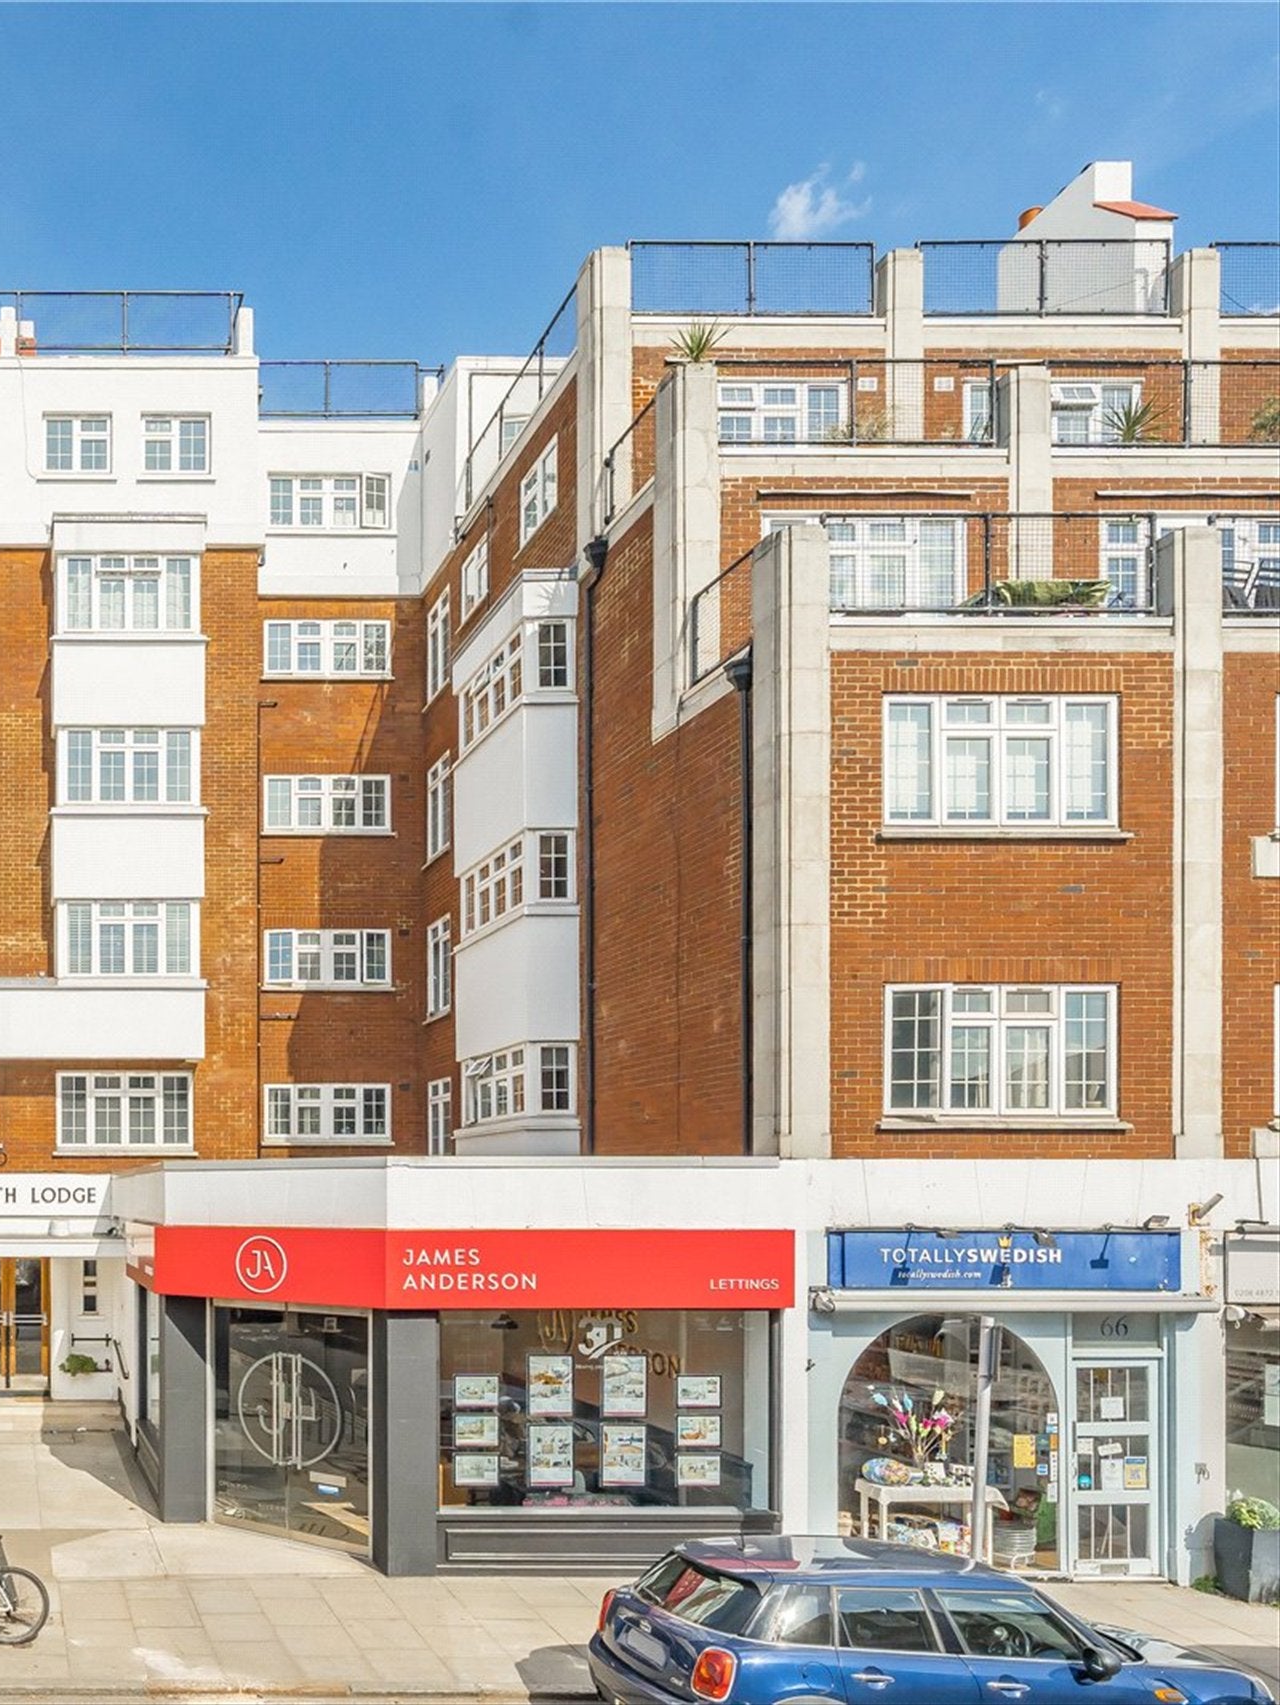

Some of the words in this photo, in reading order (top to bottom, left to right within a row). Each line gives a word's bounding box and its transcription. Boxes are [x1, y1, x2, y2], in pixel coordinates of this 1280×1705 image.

[30, 1186, 97, 1204] LODGE
[245, 1249, 276, 1280] JA
[402, 1247, 481, 1266] JAMES
[879, 1247, 1062, 1264] TOTALLYSWEDISH
[402, 1272, 538, 1291] ANDERSON
[896, 1267, 983, 1282] totallyswedish.com
[708, 1277, 780, 1291] LETTINGS
[1100, 1314, 1129, 1338] 66
